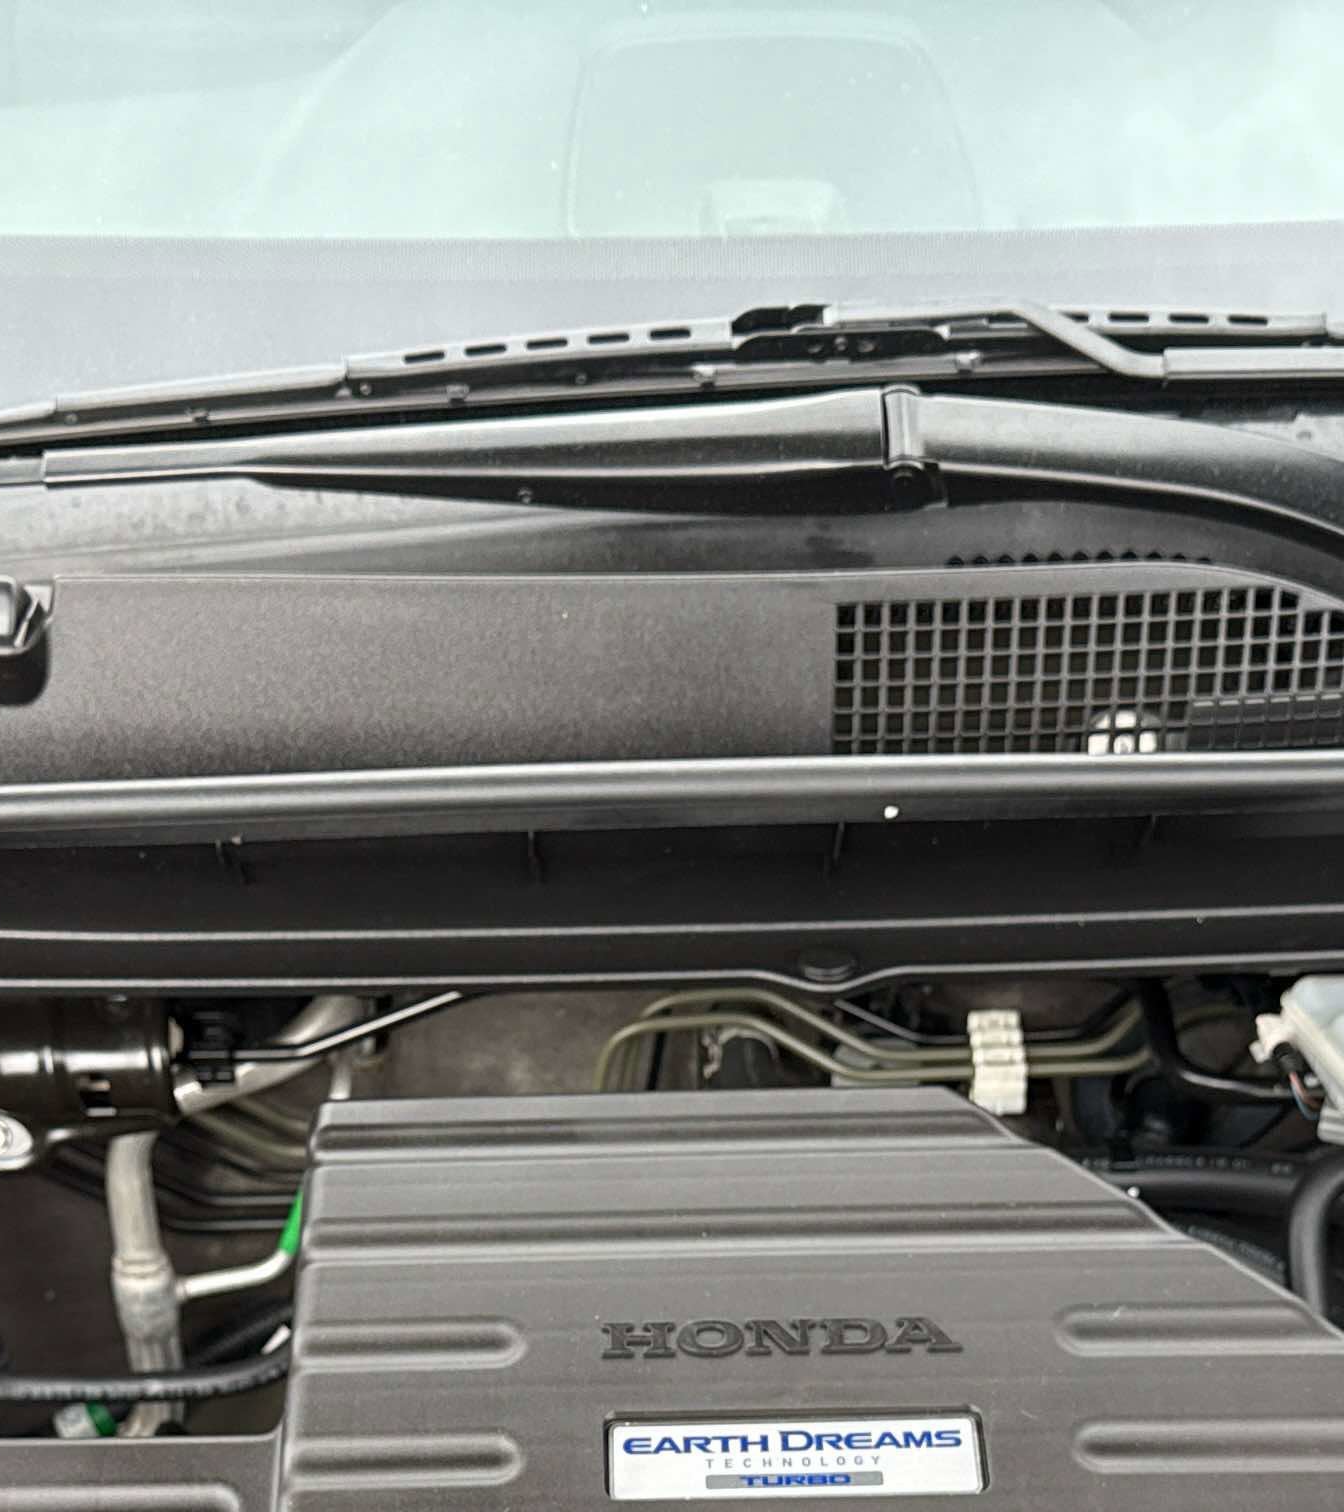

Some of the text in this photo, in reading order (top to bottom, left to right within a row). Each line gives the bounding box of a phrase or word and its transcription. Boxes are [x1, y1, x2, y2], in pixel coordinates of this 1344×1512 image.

[601, 1317, 965, 1360] HONDA
[623, 1429, 963, 1456] EARTH DREAMS
[705, 1454, 882, 1469] TECHNOLOGY
[739, 1473, 852, 1487] TURBO
